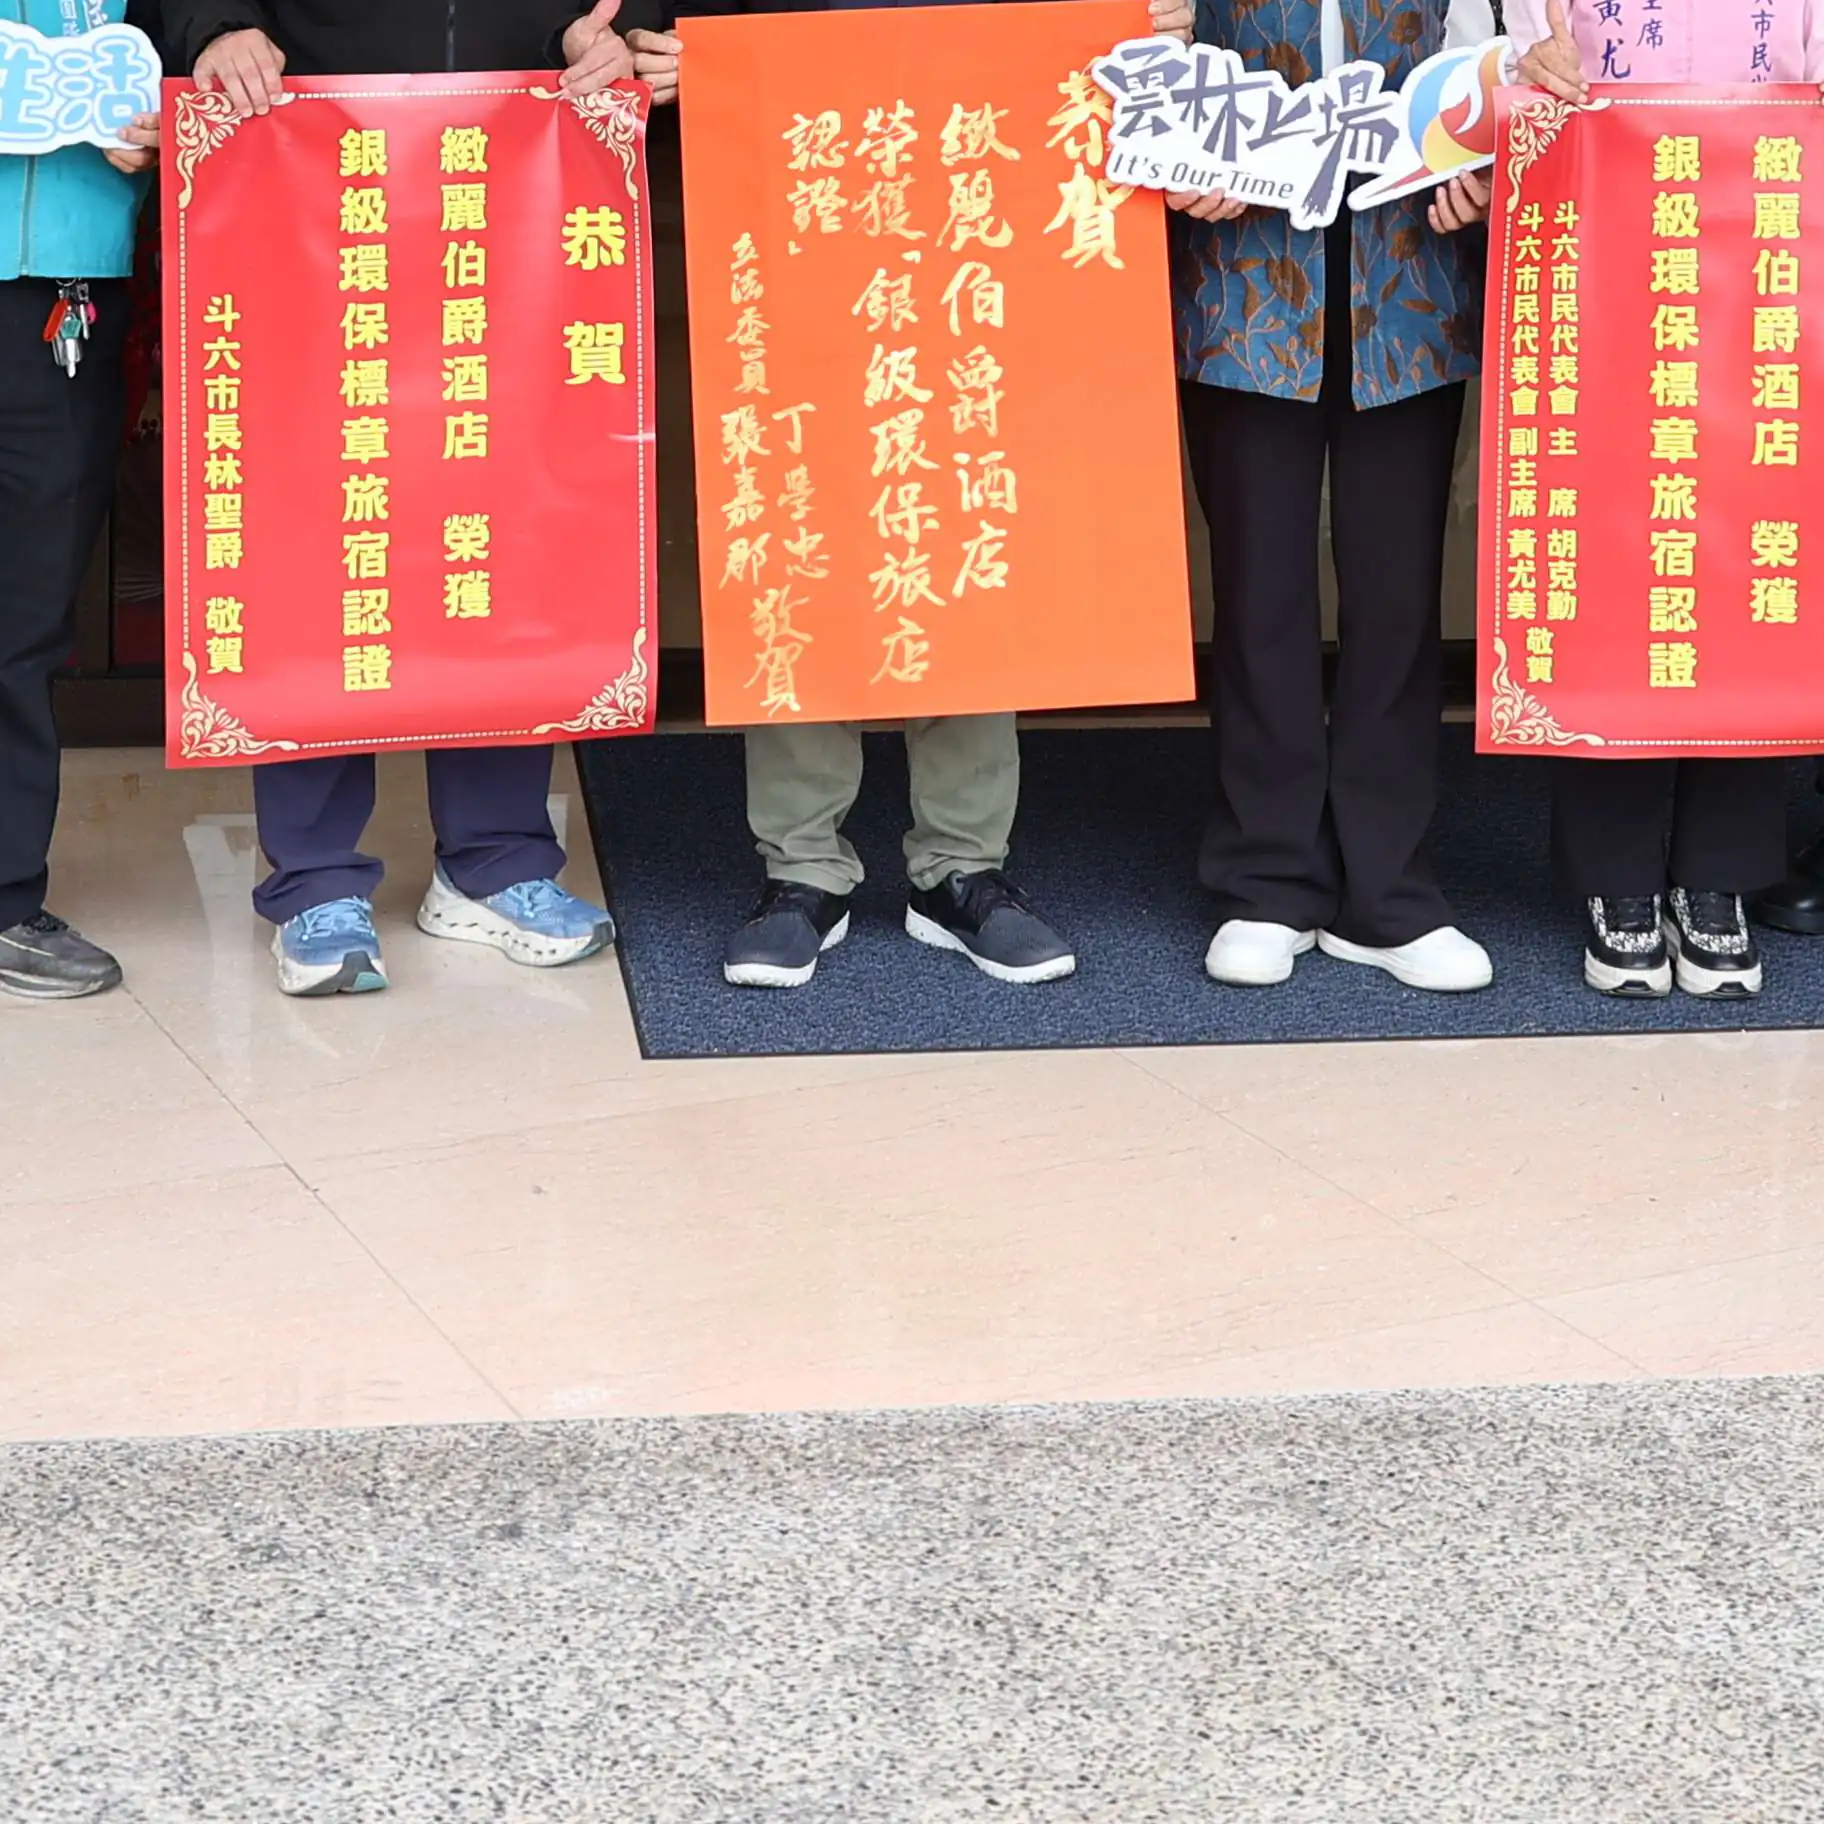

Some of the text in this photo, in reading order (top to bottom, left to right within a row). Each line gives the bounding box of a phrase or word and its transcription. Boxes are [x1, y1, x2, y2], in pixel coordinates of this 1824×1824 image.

[439, 126, 491, 619] 緻麗伯爵酒店 榮獲
[562, 206, 627, 386] 恭賀
[936, 102, 1020, 599] 緻麗伯爵酒店
[1112, 152, 1295, 199] It's Our Time
[1548, 201, 1580, 417] 斗六市民代表會
[203, 295, 244, 674] 斗六市長林聖爵 敬賀
[338, 129, 392, 693] 銀級環保標章旅宿認證
[1506, 202, 1543, 621] 斗六市民代表會 副主席 黃尤美
[1546, 528, 1578, 621] 胡克勤
[1648, 135, 1701, 690] 銀級環保標章旅宿認證
[1750, 136, 1803, 626] 緻麗伯爵酒店 榮獲
[1526, 626, 1555, 685] 敬賀
